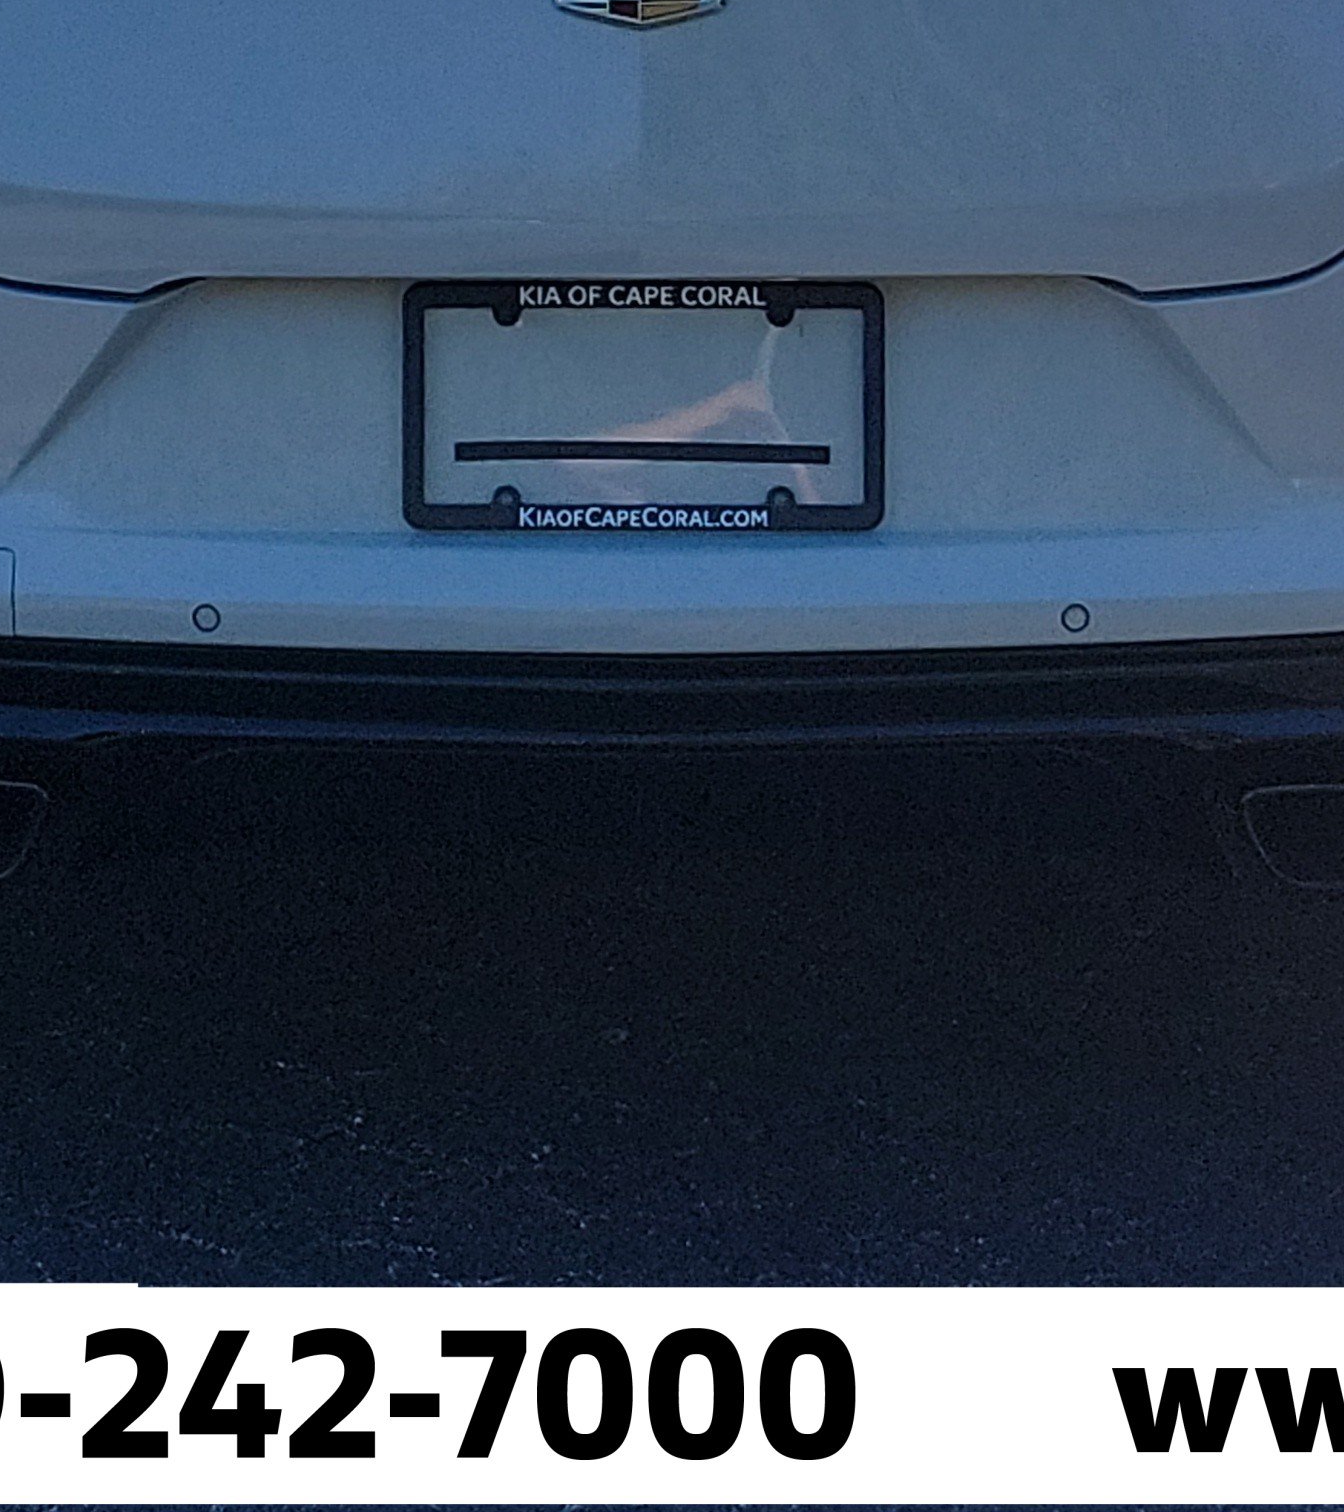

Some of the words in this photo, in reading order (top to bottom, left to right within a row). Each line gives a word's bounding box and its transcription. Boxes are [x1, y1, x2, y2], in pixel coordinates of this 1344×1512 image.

[519, 285, 562, 306] KIA
[568, 285, 602, 306] OF
[608, 285, 674, 306] CAPE
[680, 285, 767, 306] CORAL
